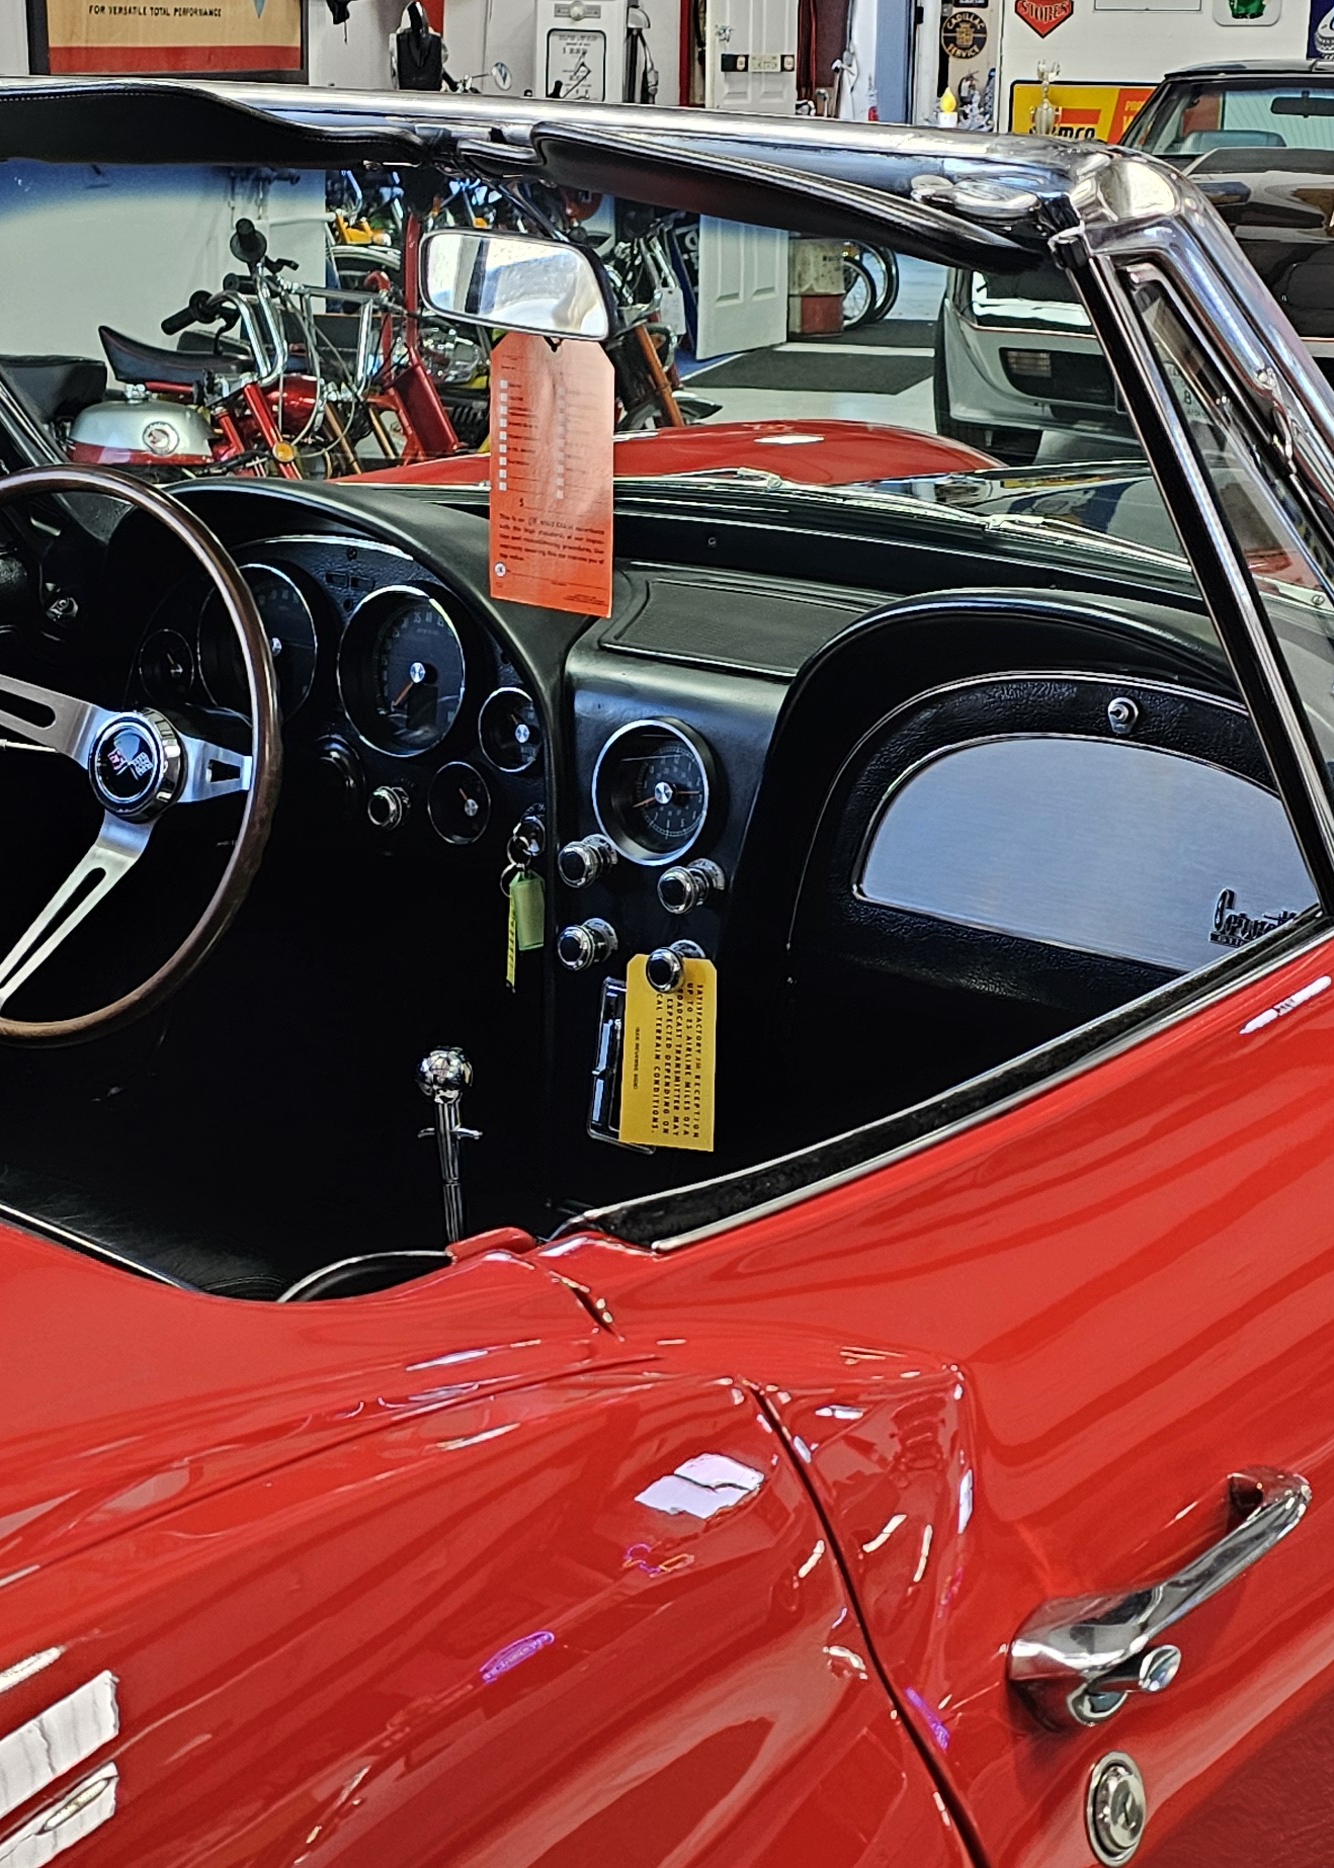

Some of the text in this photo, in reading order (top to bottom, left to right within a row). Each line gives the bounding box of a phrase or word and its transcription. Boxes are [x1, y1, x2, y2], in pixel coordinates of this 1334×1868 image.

[89, 5, 222, 18] FOR VERSATILE TOTAL PERFORMANCE
[947, 13, 985, 30] CADILLAC
[1018, 1, 1070, 23] STORES
[686, 982, 694, 996] UP
[686, 1000, 693, 1013] TO
[654, 1016, 663, 1061] TERRAIN
[695, 984, 704, 1055] SATISFACTORY
[662, 998, 673, 1135] EXPECTED DEPENDING ON
[672, 986, 684, 1137] ROADCAST TRANSMITTER MAY
[684, 1035, 692, 1077] AIRLINE
[651, 1065, 662, 1134] CONDITIONS.
[683, 1081, 692, 1111] MILES
[692, 1074, 702, 1139] RECEPTION
